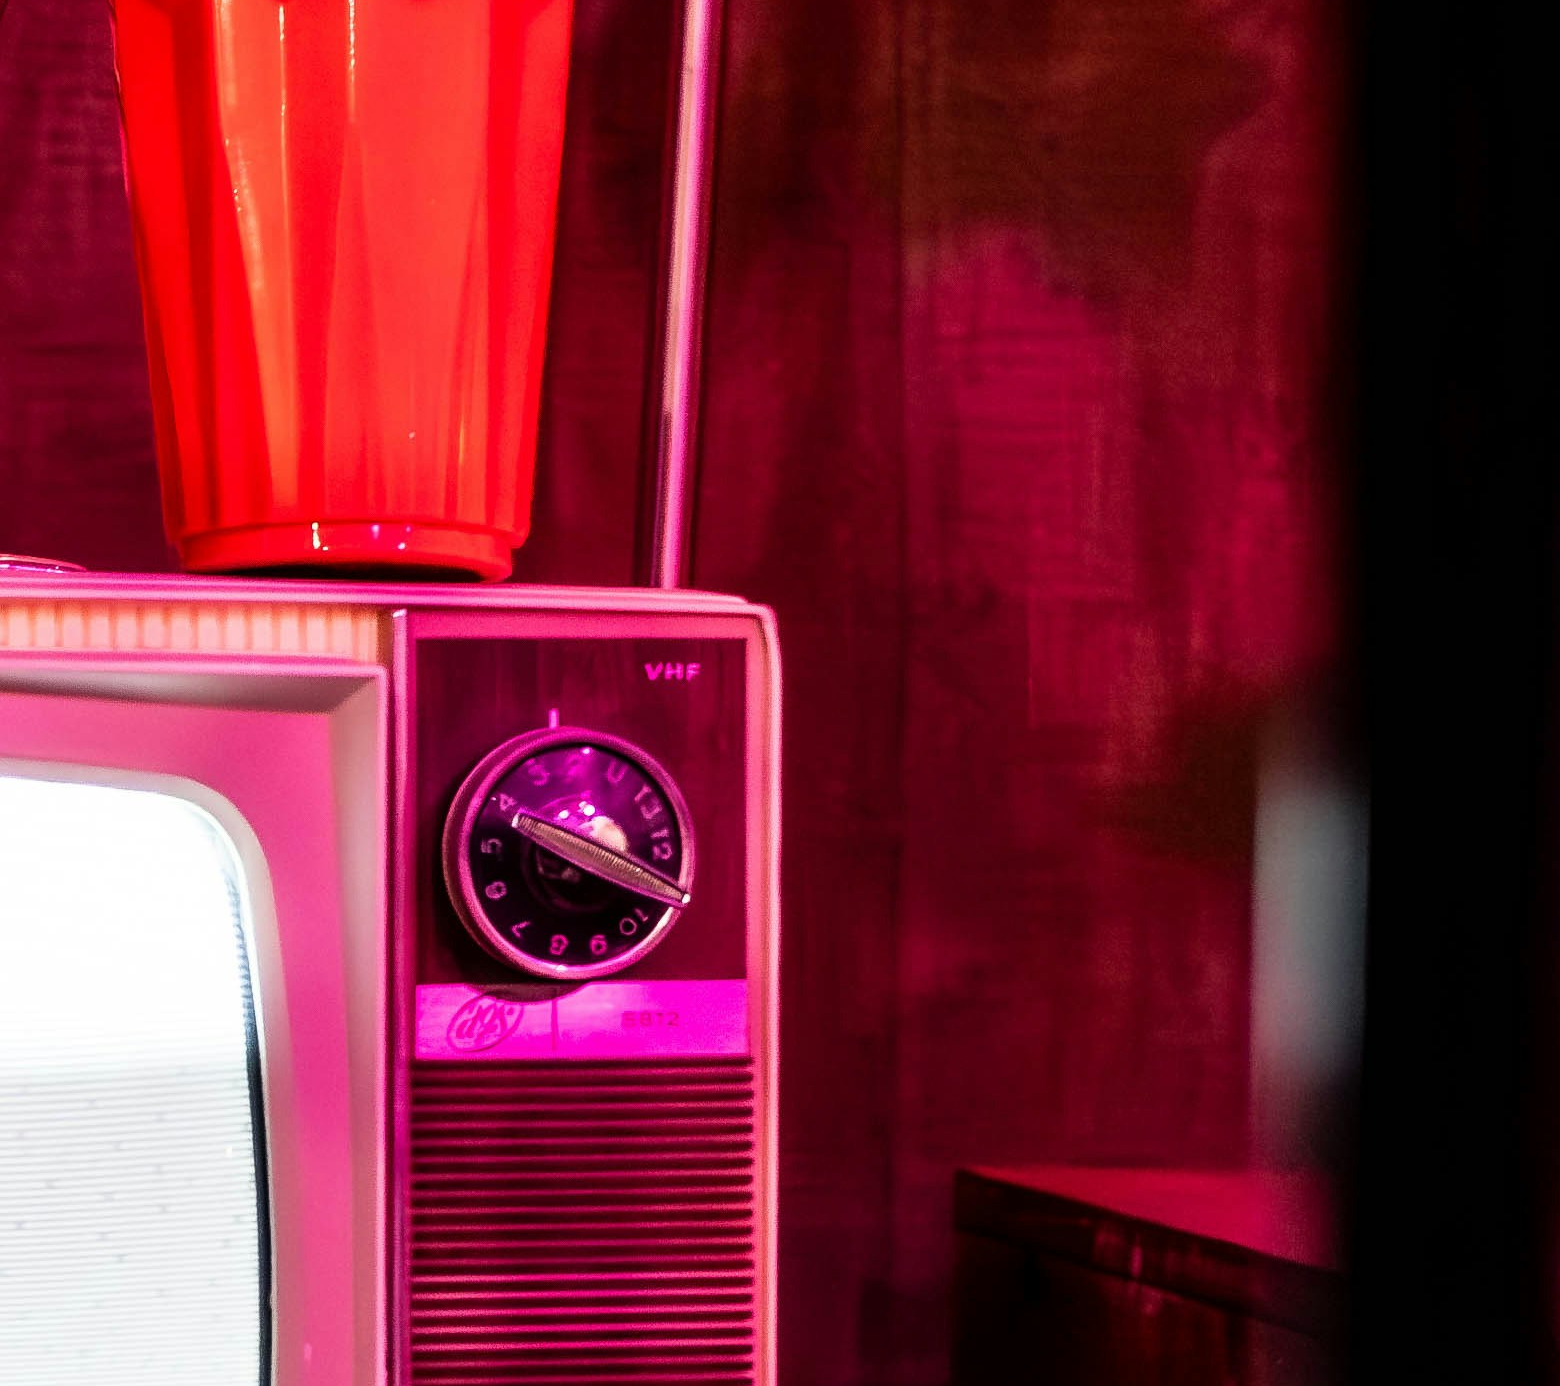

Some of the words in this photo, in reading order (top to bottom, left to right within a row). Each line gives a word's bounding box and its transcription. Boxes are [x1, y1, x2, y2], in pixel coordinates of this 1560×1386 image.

[644, 661, 701, 682] VHF
[498, 793, 518, 812] 4
[650, 827, 673, 861] 12
[485, 880, 508, 900] 6
[511, 920, 531, 938] 7
[618, 907, 649, 936] 10
[549, 934, 569, 956] 8
[589, 934, 608, 955] 9
